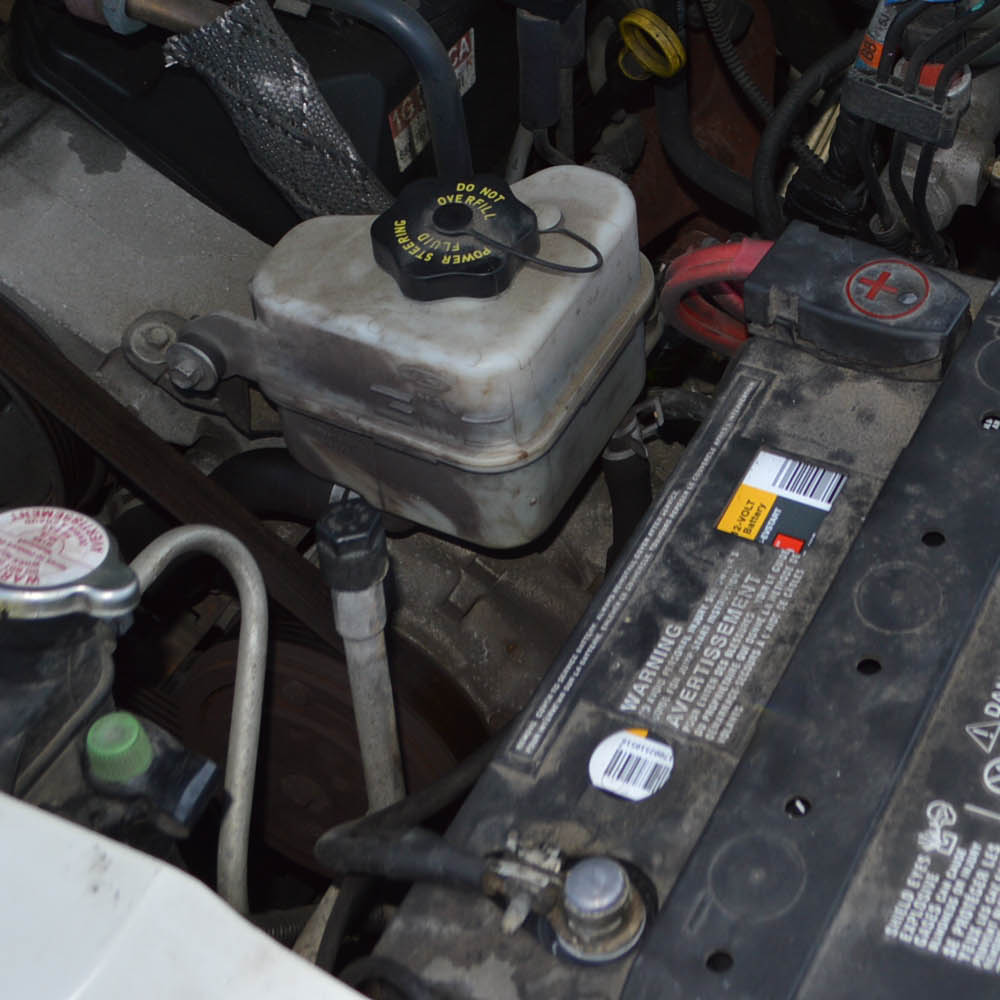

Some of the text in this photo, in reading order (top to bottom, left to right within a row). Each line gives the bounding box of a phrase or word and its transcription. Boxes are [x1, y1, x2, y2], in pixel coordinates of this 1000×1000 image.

[437, 194, 496, 220] OVERFILL
[456, 183, 506, 203] DO NOT
[394, 219, 492, 264] POWER STEERING
[418, 233, 460, 252] FLUID
[744, 504, 766, 534] Battery
[623, 619, 683, 714] WARNING
[664, 573, 761, 728] AVERTISSEMENT
[883, 852, 932, 937] SHIELD EYES
